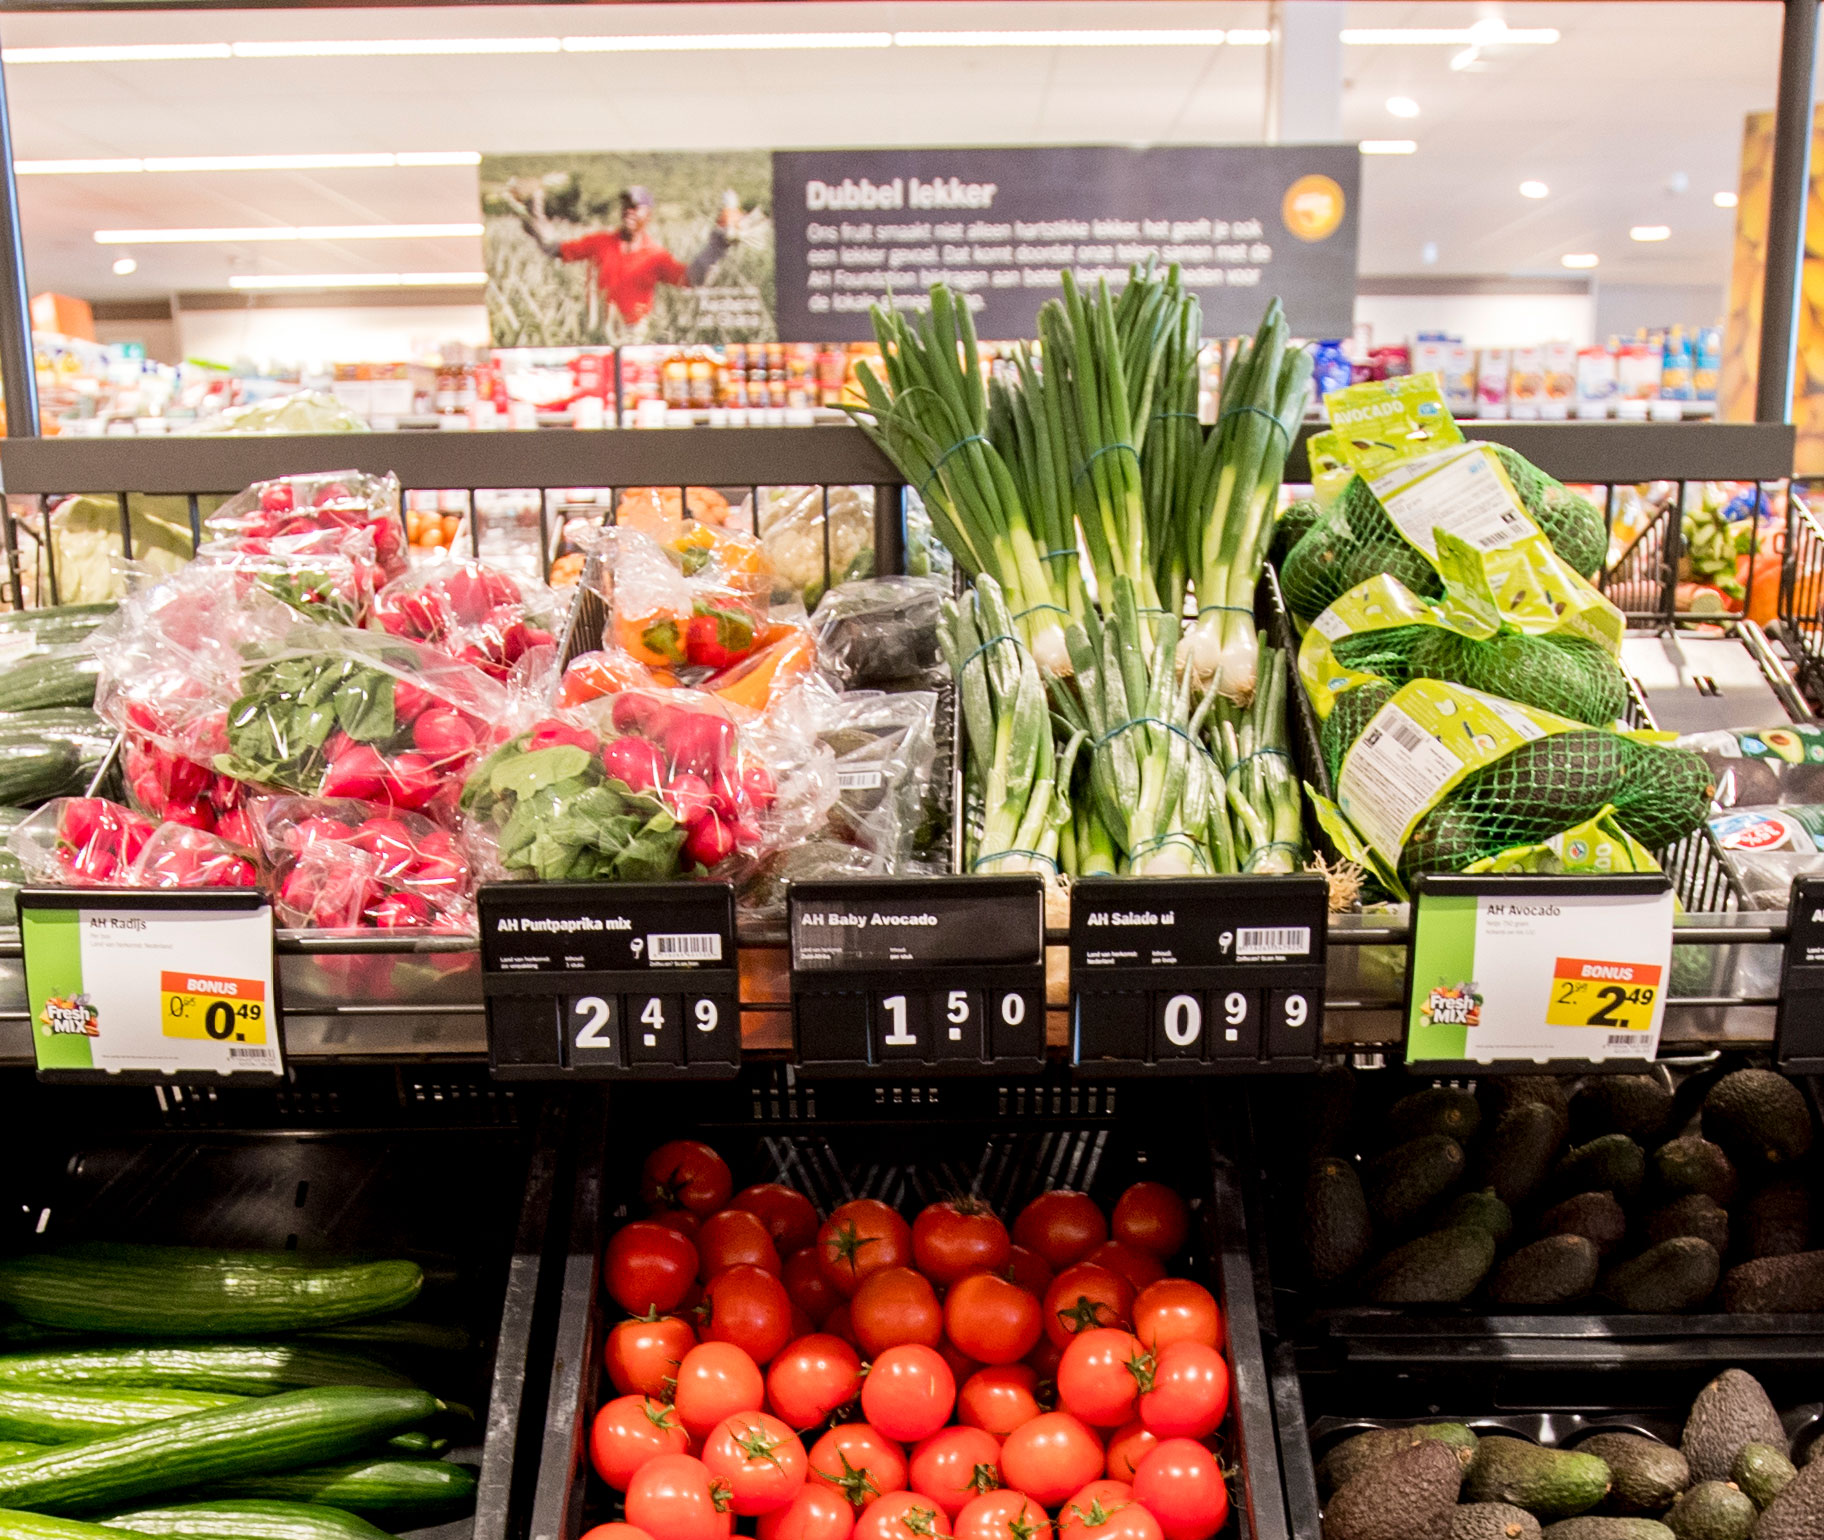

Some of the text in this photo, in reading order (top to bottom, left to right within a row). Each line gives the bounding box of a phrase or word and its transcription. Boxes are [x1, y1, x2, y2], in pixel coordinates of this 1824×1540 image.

[806, 177, 998, 210] Dubbel lekker
[1333, 400, 1405, 425] AVOCADO
[1087, 910, 1175, 926] AH Salade ui
[1487, 905, 1561, 916] AH Avocado
[89, 916, 147, 932] AH Radijs
[497, 917, 632, 933] AH Puntpaprika mix
[801, 913, 938, 928] AH Baby Avocado
[1581, 965, 1633, 980] BONUS
[186, 978, 238, 995] BONUS
[1430, 995, 1474, 1010] Fresh
[47, 1005, 90, 1020] Fresh
